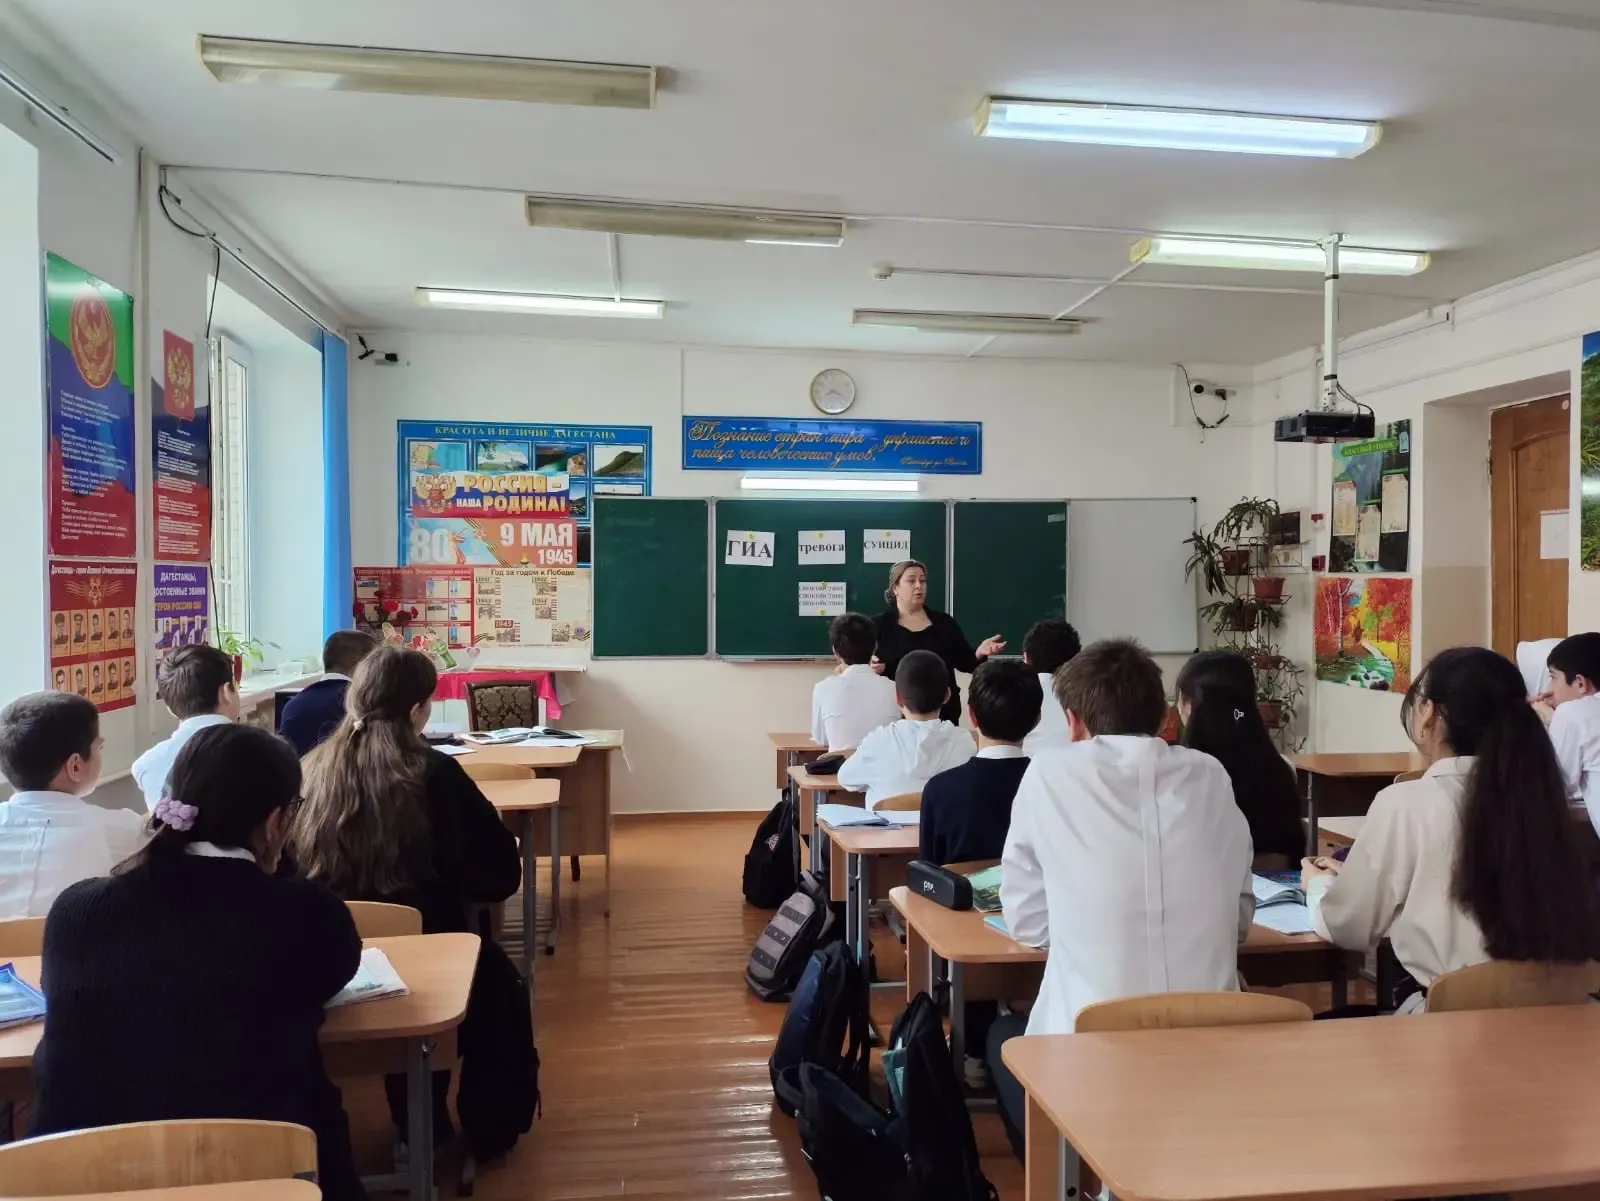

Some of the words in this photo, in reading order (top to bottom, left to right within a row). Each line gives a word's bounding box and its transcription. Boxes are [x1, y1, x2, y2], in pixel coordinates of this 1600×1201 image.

[434, 425, 485, 436] КРАСОТА
[487, 427, 496, 436] И
[498, 428, 550, 437] ВЕЛИЧИЕ
[552, 428, 617, 439] ДАГЕСТАНА
[688, 420, 771, 449] Познание
[774, 431, 822, 449] стран
[825, 431, 865, 449] мира
[691, 448, 735, 463] пища
[463, 475, 548, 494] РОССИЯ
[456, 497, 482, 508] НАША
[483, 495, 566, 515] РОДИНА!
[500, 522, 515, 547] 9
[520, 522, 573, 547] МАЯ
[409, 527, 449, 564] 80
[727, 539, 773, 559] ГИА
[799, 542, 846, 555] тревога
[537, 549, 573, 565] 1945
